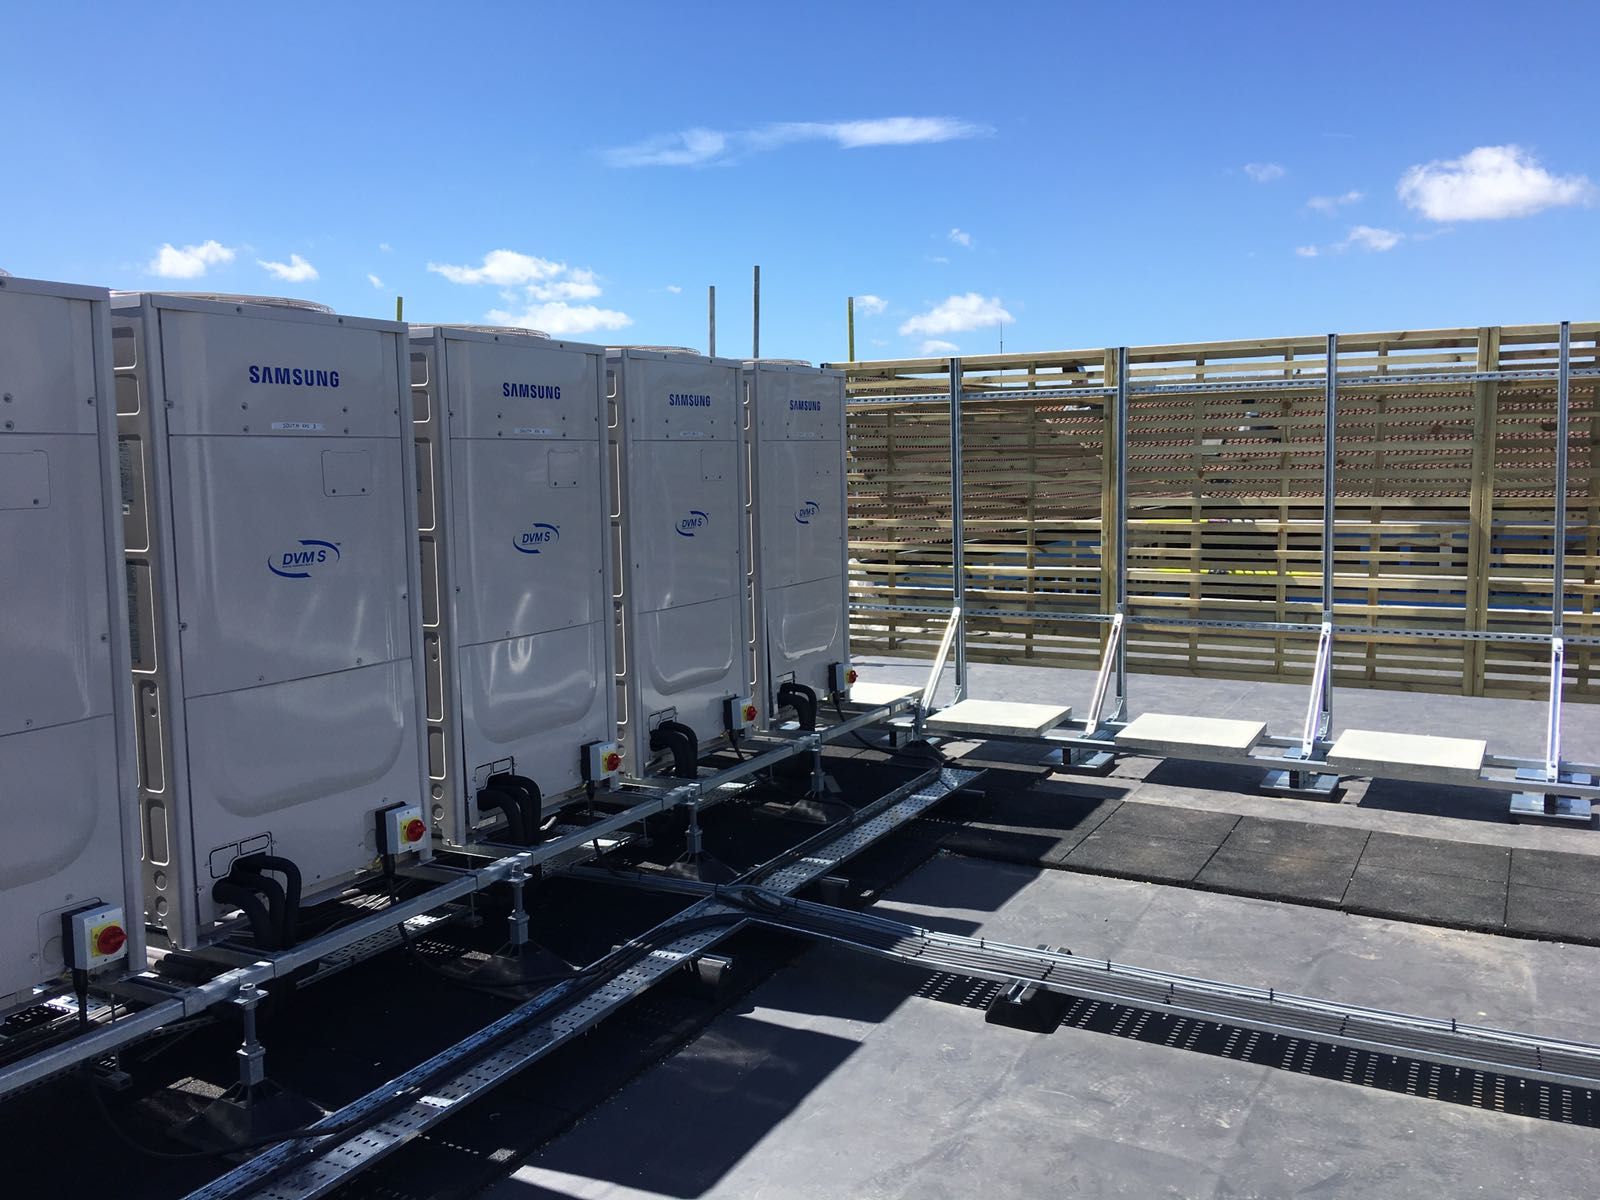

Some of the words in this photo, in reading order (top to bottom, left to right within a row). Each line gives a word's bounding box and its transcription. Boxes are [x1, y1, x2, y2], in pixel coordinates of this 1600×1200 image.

[248, 365, 340, 388] SAMSUNG
[502, 382, 561, 400] SAMSUNG
[669, 393, 711, 407] SAMSUNG
[789, 399, 821, 411] SAMSUNG
[681, 518, 697, 528] DVM
[522, 532, 543, 544] DVM
[282, 551, 315, 566] DVM
[317, 549, 326, 563] S
